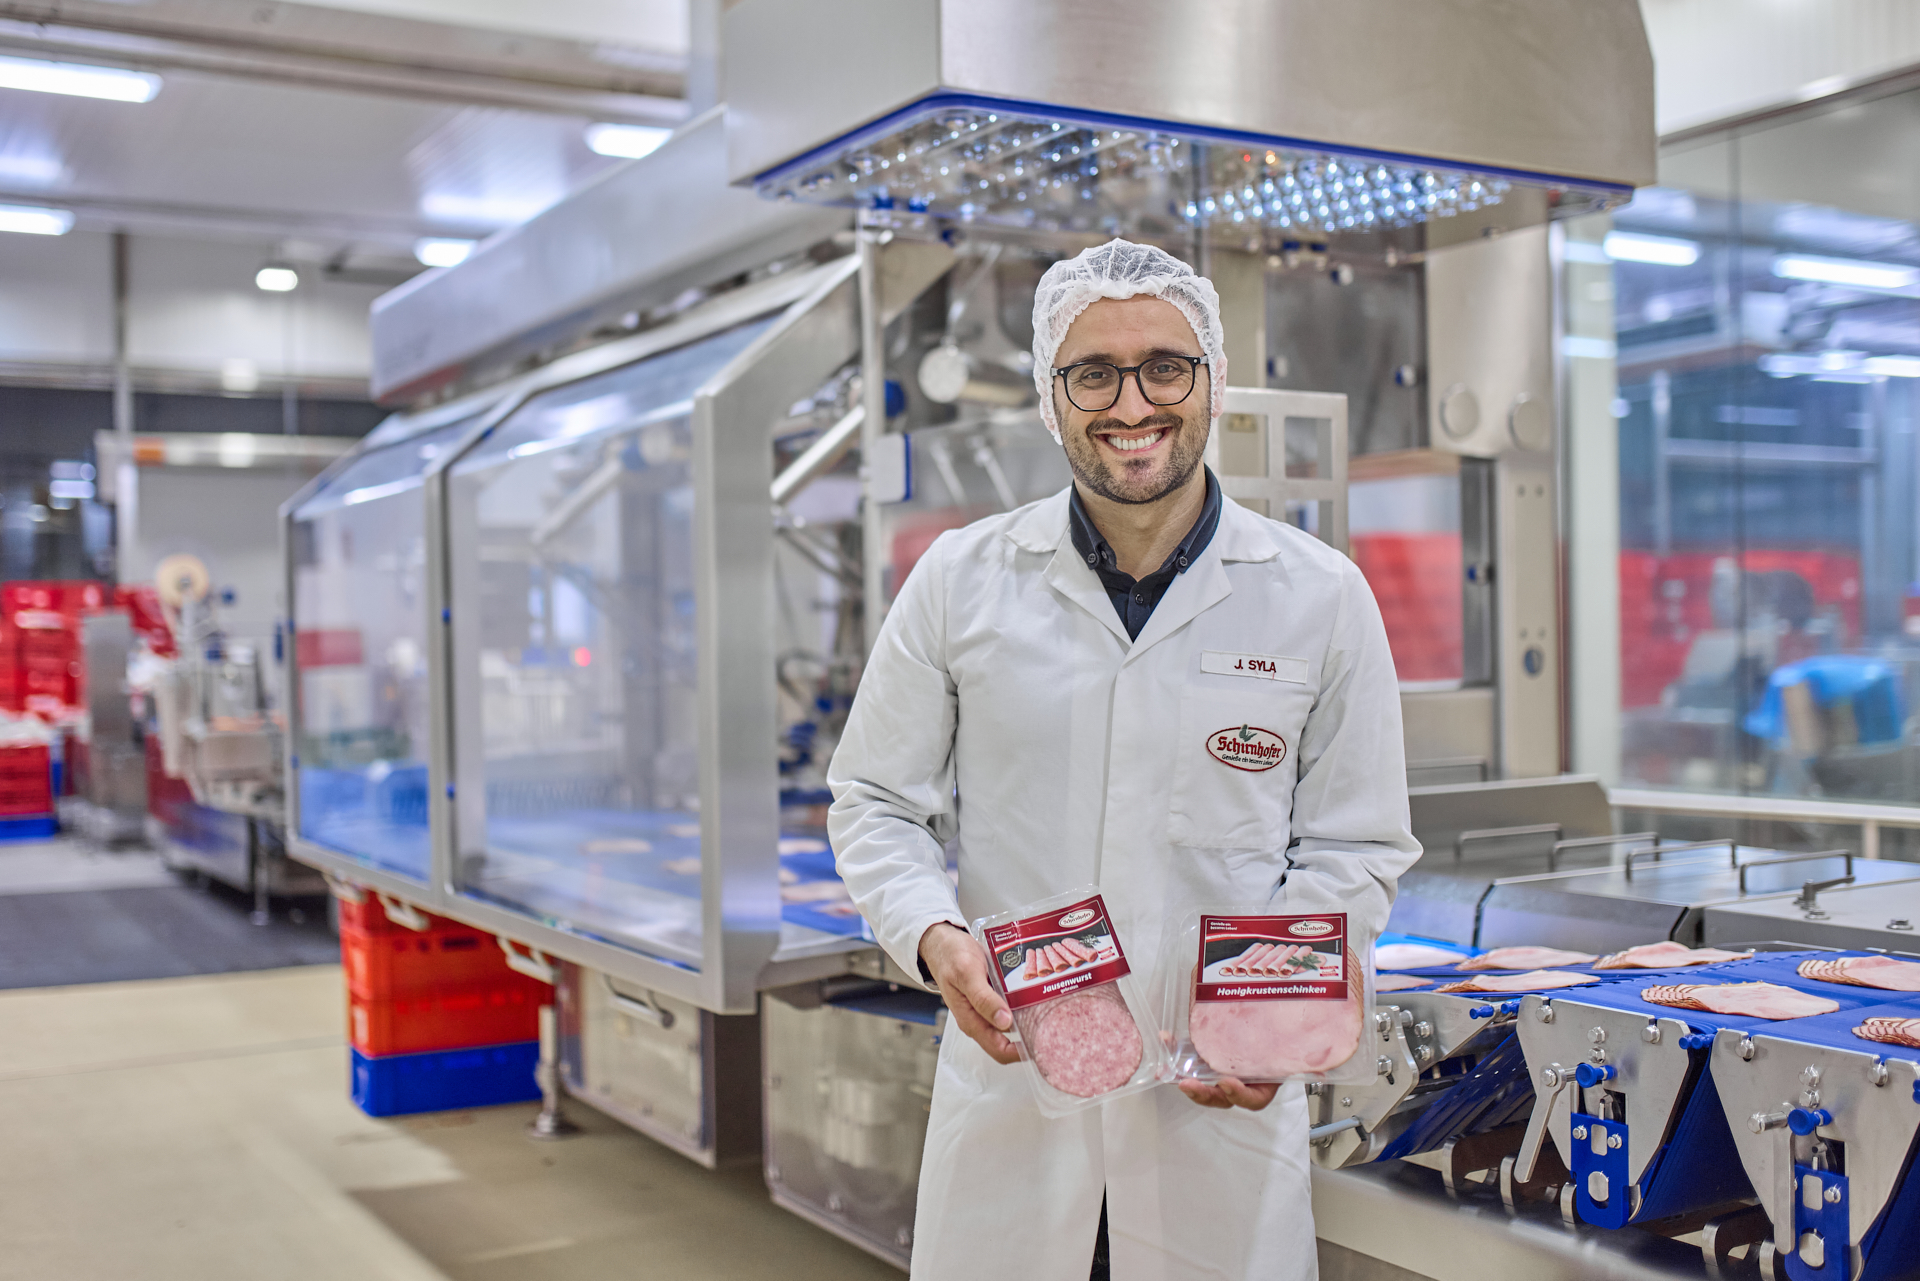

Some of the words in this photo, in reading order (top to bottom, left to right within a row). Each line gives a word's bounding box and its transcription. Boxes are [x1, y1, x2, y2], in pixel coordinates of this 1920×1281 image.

[1234, 659, 1244, 670] J.
[1248, 660, 1277, 673] SYLA
[1217, 736, 1282, 759] Schirnhofer
[1042, 972, 1092, 994] Jausenwurst
[1217, 985, 1327, 997] Honigkrustenschinken
